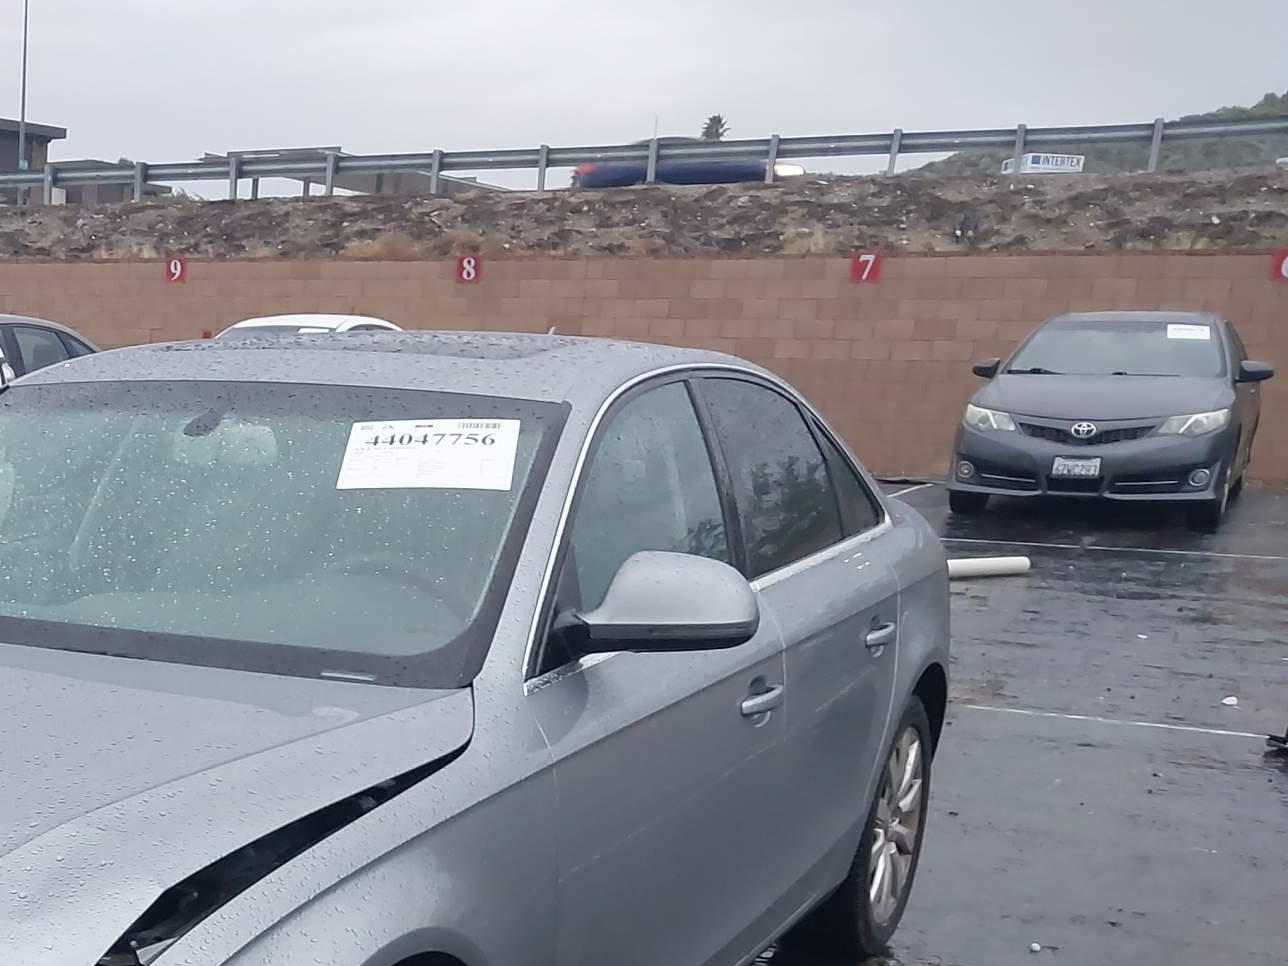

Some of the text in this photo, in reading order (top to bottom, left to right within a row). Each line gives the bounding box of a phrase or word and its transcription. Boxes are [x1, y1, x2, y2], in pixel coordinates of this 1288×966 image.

[1041, 154, 1082, 169] INTERTEX
[170, 259, 182, 281] 9
[462, 257, 476, 281] 8
[859, 254, 876, 281] 7
[365, 433, 496, 446] 44047756
